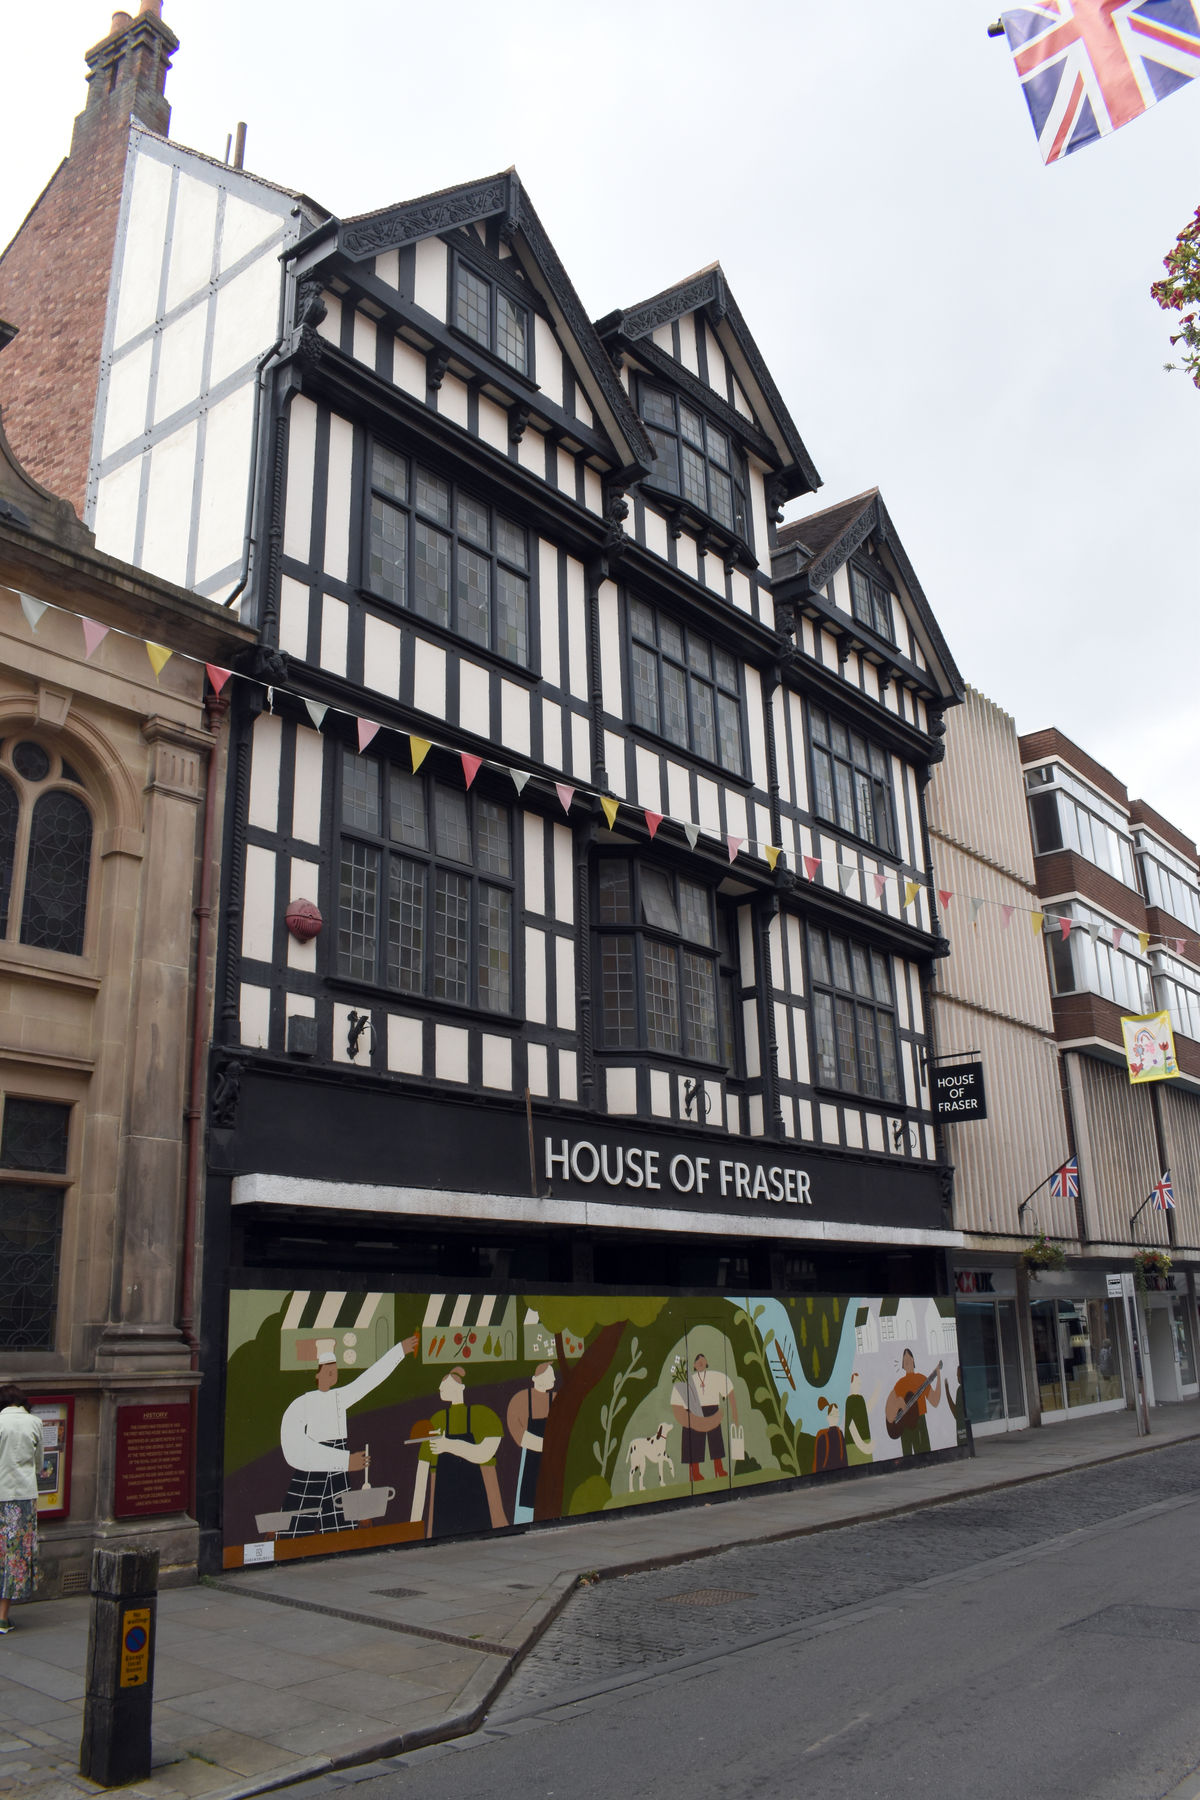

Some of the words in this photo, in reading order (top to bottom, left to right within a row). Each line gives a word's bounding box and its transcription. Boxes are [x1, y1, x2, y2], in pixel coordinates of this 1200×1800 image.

[937, 1074, 975, 1088] HOUSE
[949, 1087, 965, 1099] OF
[938, 1098, 978, 1113] FRASER
[545, 1136, 661, 1189] HOUSE
[669, 1154, 710, 1194] OF
[719, 1159, 813, 1205] FRASER
[974, 1271, 996, 1292] UK
[143, 1411, 169, 1419] HISTORY
